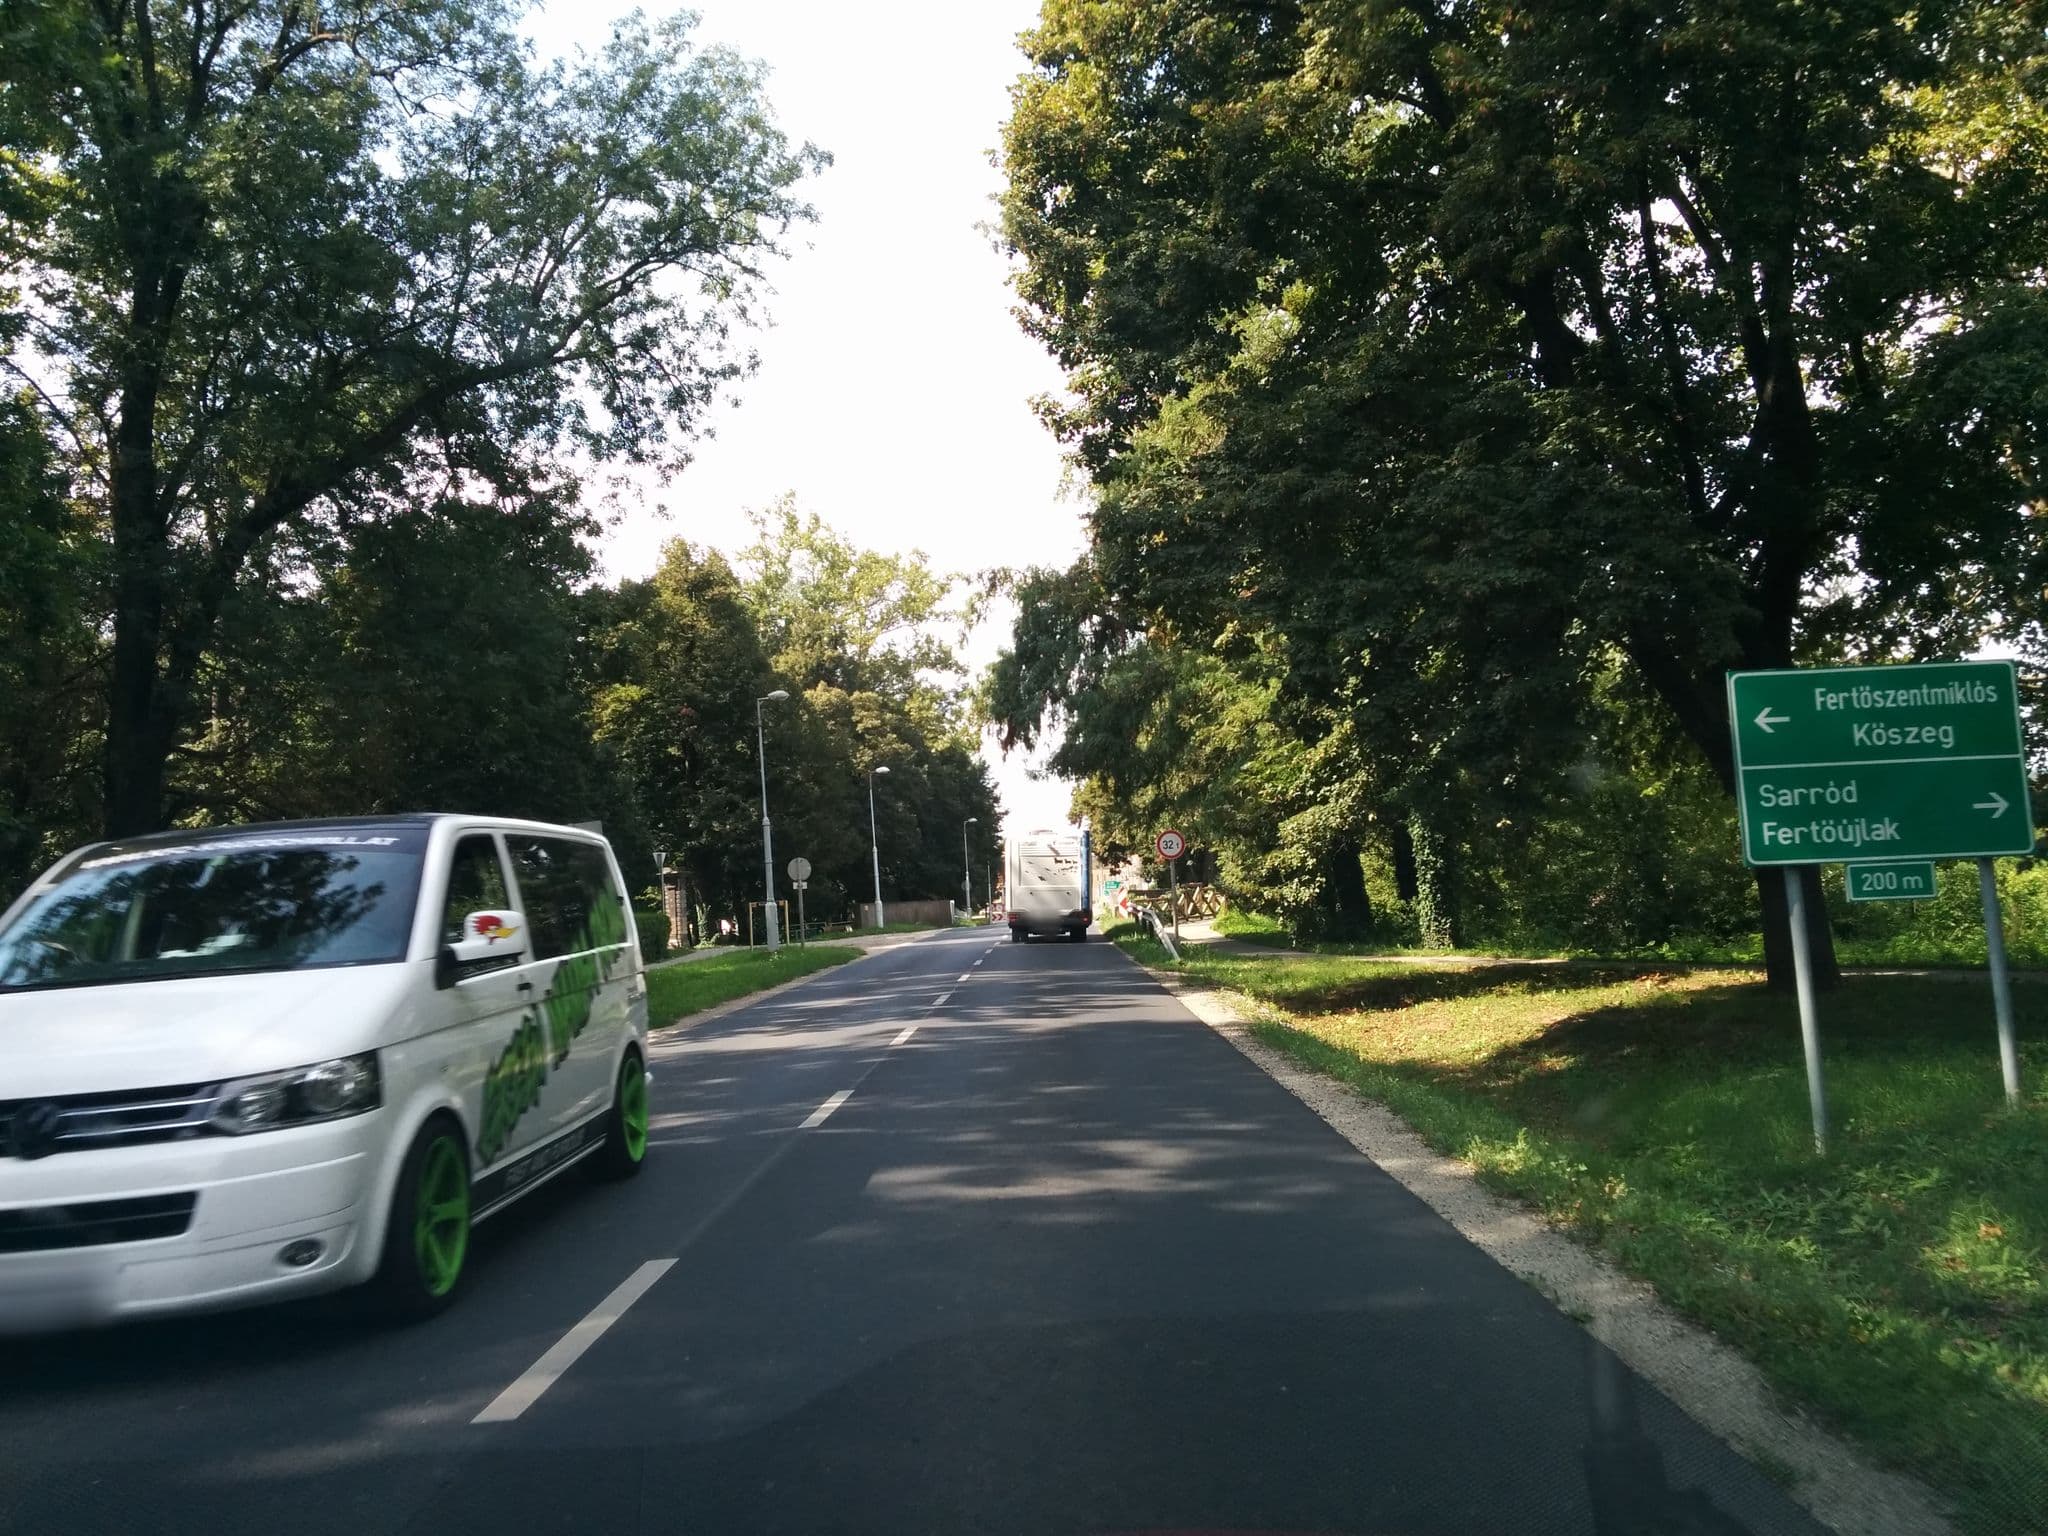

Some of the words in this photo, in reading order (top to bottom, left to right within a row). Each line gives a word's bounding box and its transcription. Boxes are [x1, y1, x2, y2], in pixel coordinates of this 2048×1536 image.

[1759, 780, 1858, 807] Sarród
[1162, 840, 1174, 849] 32
[1861, 871, 1897, 891] 200
[1902, 874, 1923, 889] m
